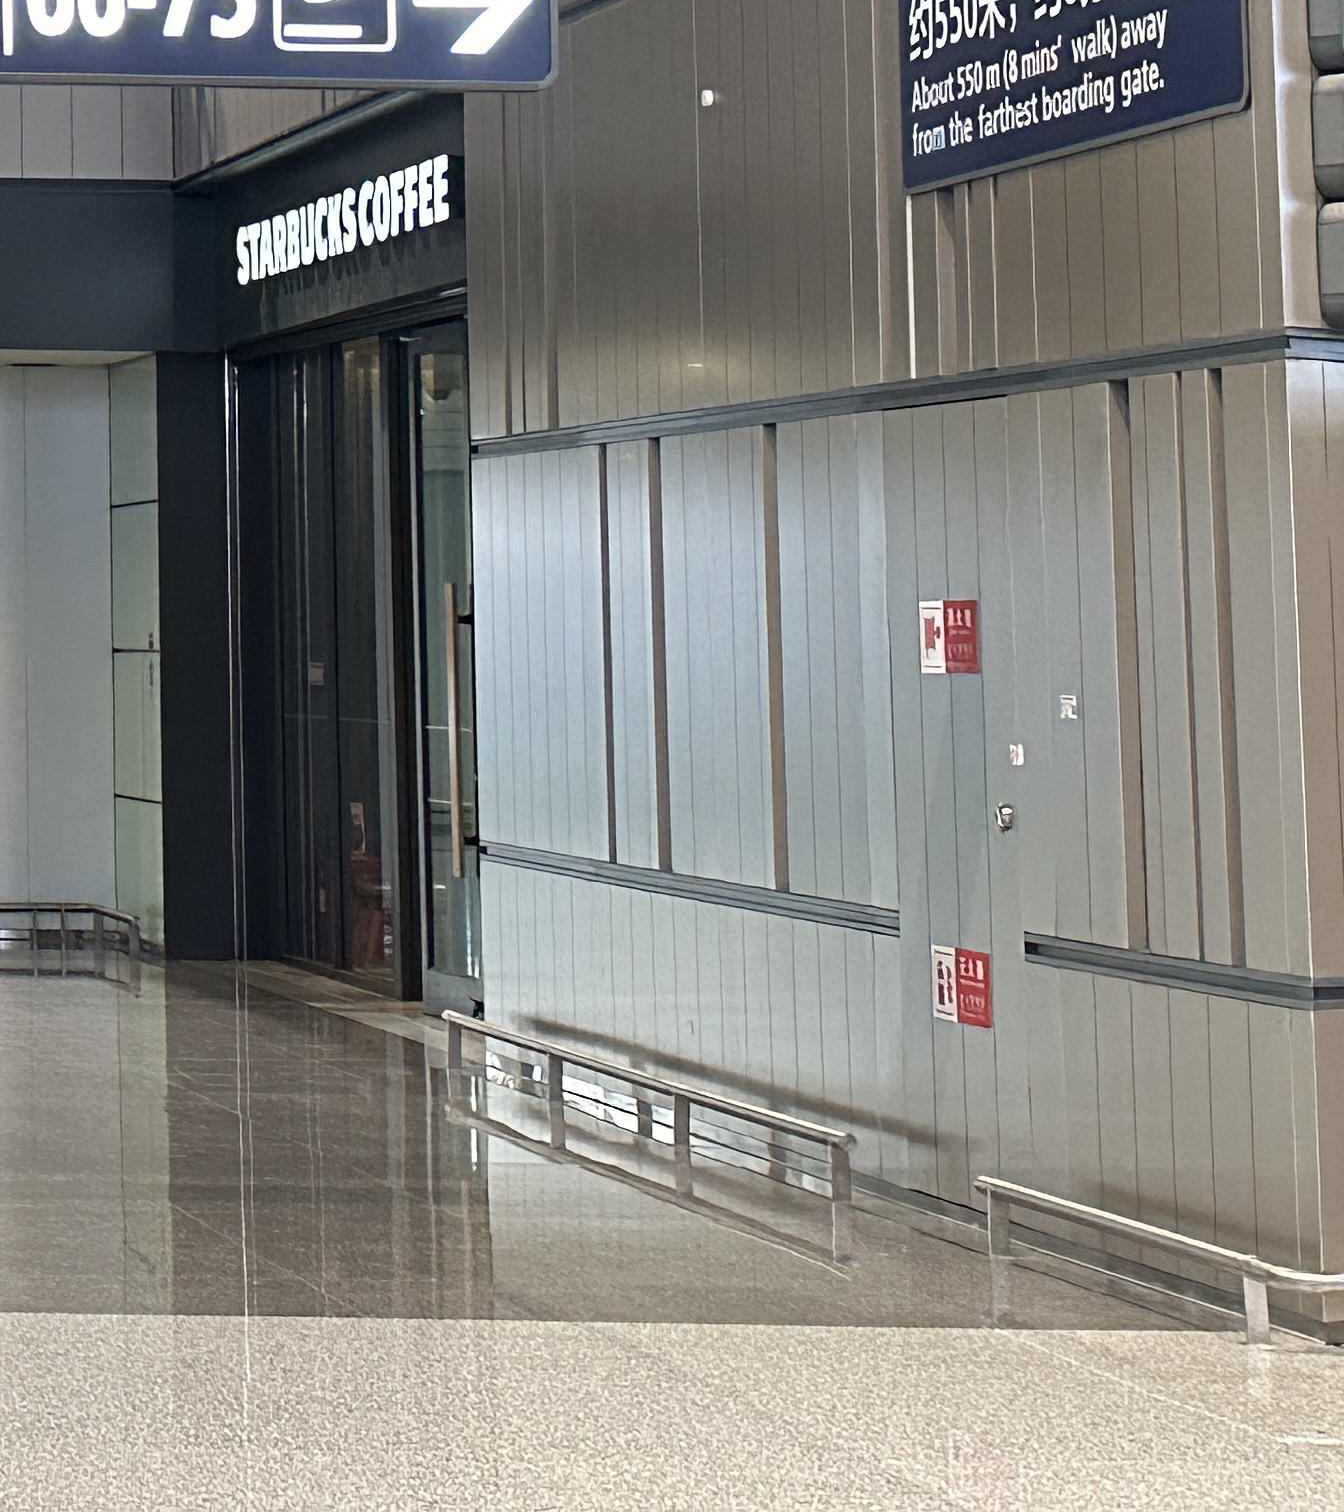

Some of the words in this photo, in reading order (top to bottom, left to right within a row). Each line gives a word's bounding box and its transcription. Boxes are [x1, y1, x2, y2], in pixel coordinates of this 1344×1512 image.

[912, 72, 955, 113] About
[957, 60, 983, 100] 550
[986, 63, 1000, 90] m
[1003, 49, 1018, 90] (8
[1071, 15, 1117, 63] walk)
[1121, 9, 1168, 49] away
[912, 123, 946, 157] from
[949, 111, 973, 146] the
[978, 93, 1039, 139] farthest
[1042, 72, 1115, 121] boarding
[1121, 60, 1164, 108] gate.
[236, 187, 357, 286] STARBUCKS
[358, 154, 450, 247] COFFEE
